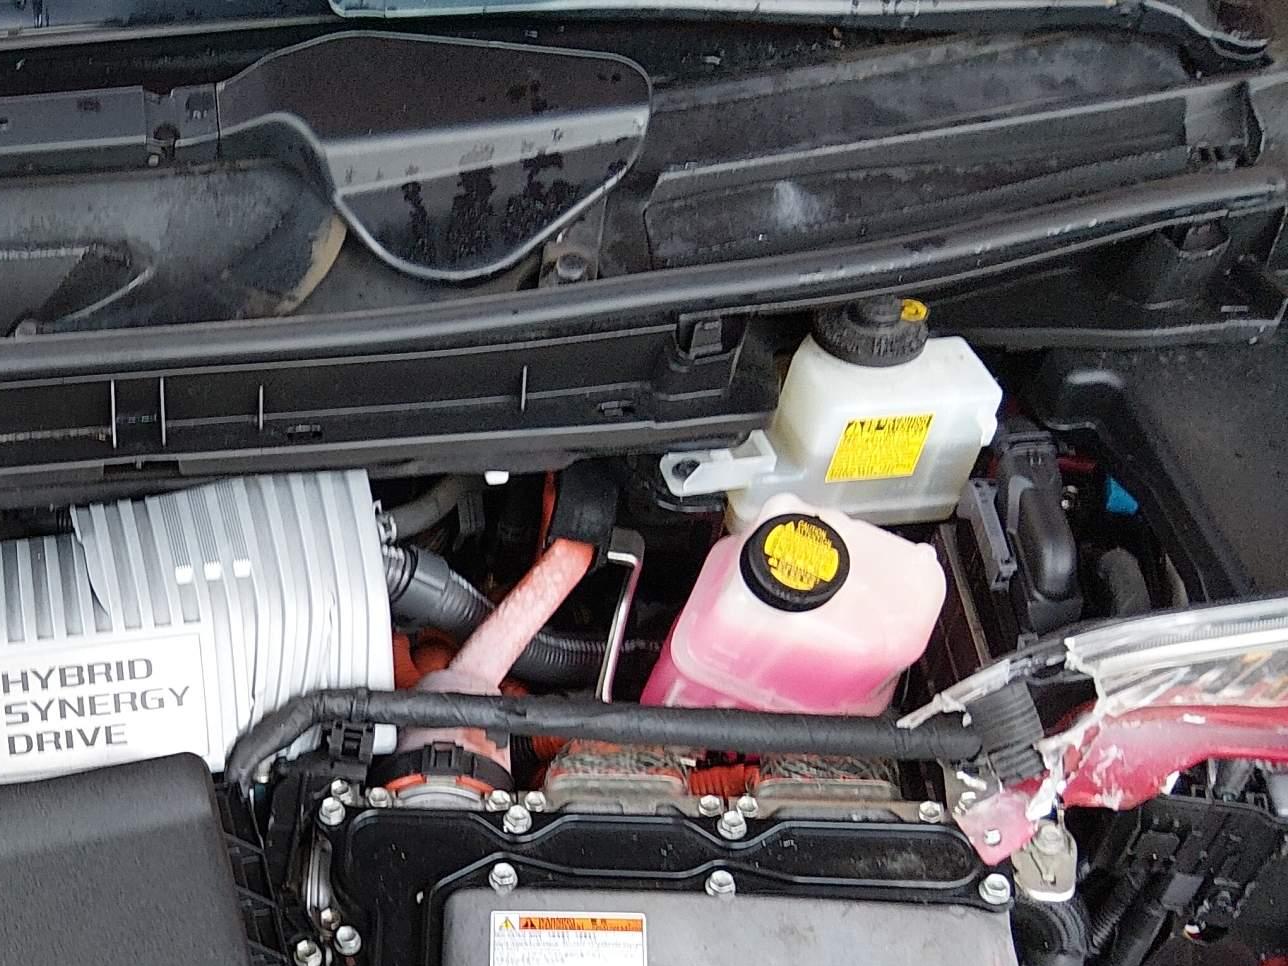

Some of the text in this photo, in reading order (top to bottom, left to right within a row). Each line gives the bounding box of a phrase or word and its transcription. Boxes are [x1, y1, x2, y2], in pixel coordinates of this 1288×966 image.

[1, 657, 153, 695] HYBRID
[3, 685, 190, 726] SYNERGY
[7, 723, 128, 755] DRIVE
